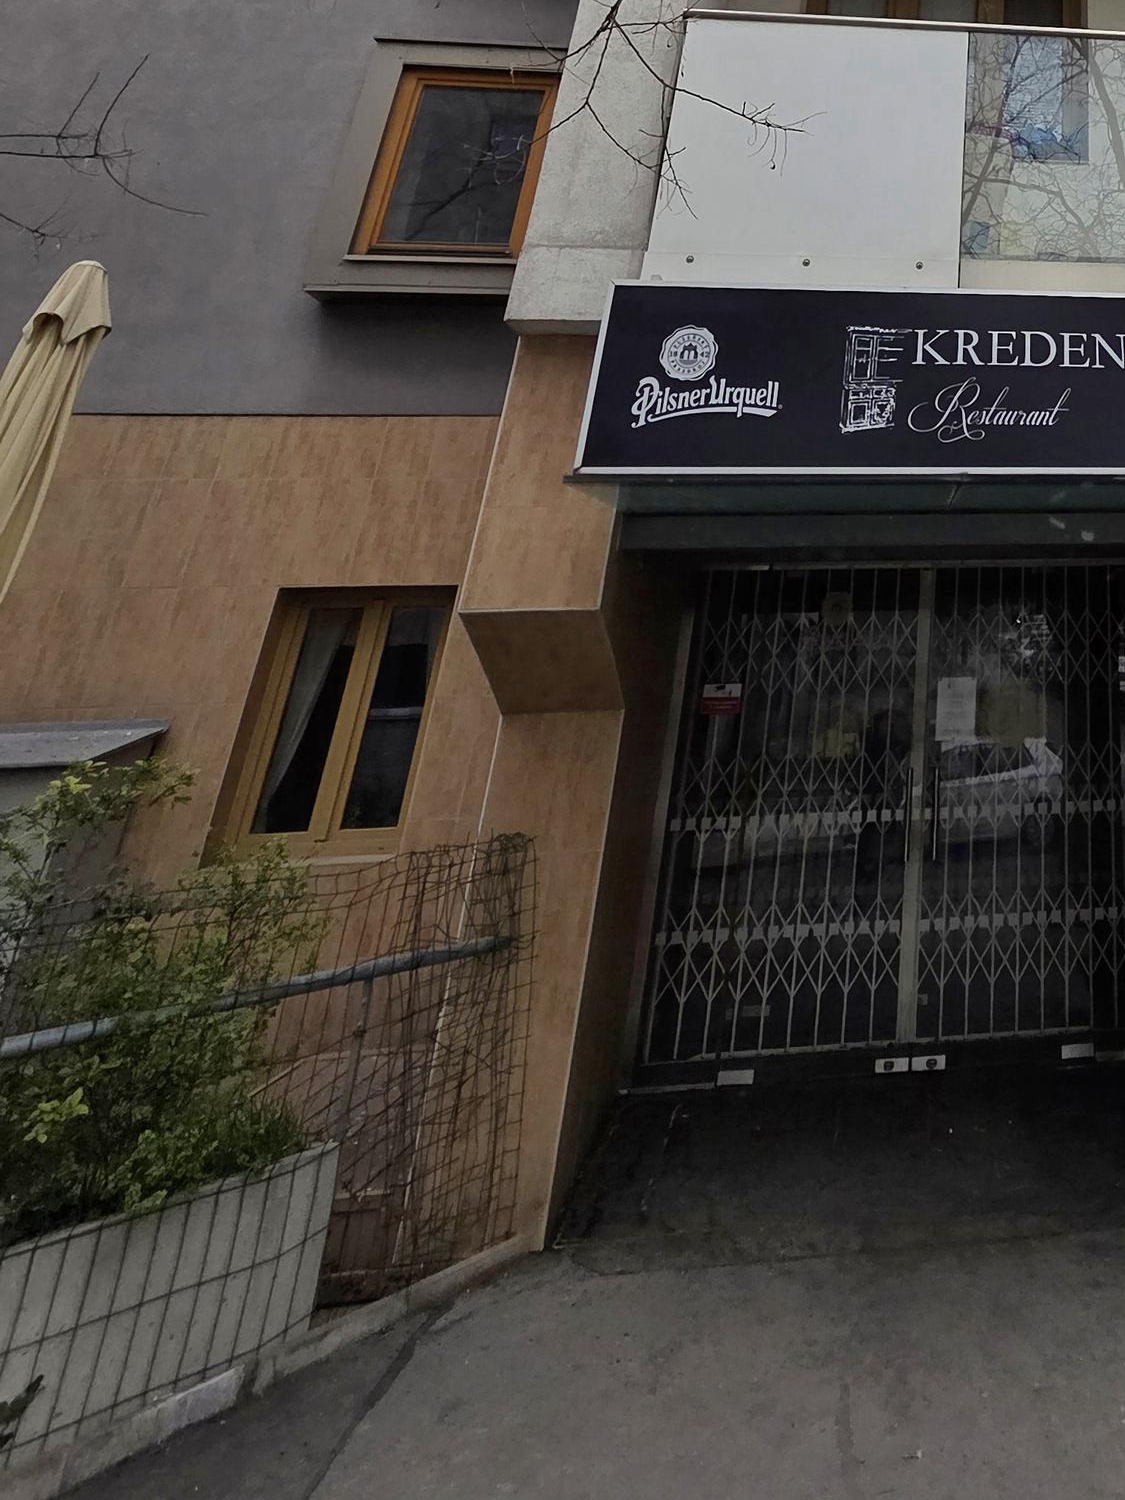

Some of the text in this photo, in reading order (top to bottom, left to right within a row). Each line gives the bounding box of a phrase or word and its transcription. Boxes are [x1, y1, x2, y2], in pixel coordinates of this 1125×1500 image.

[631, 375, 779, 428] Pilsner Urquell
[908, 377, 1071, 443] Restaurant
